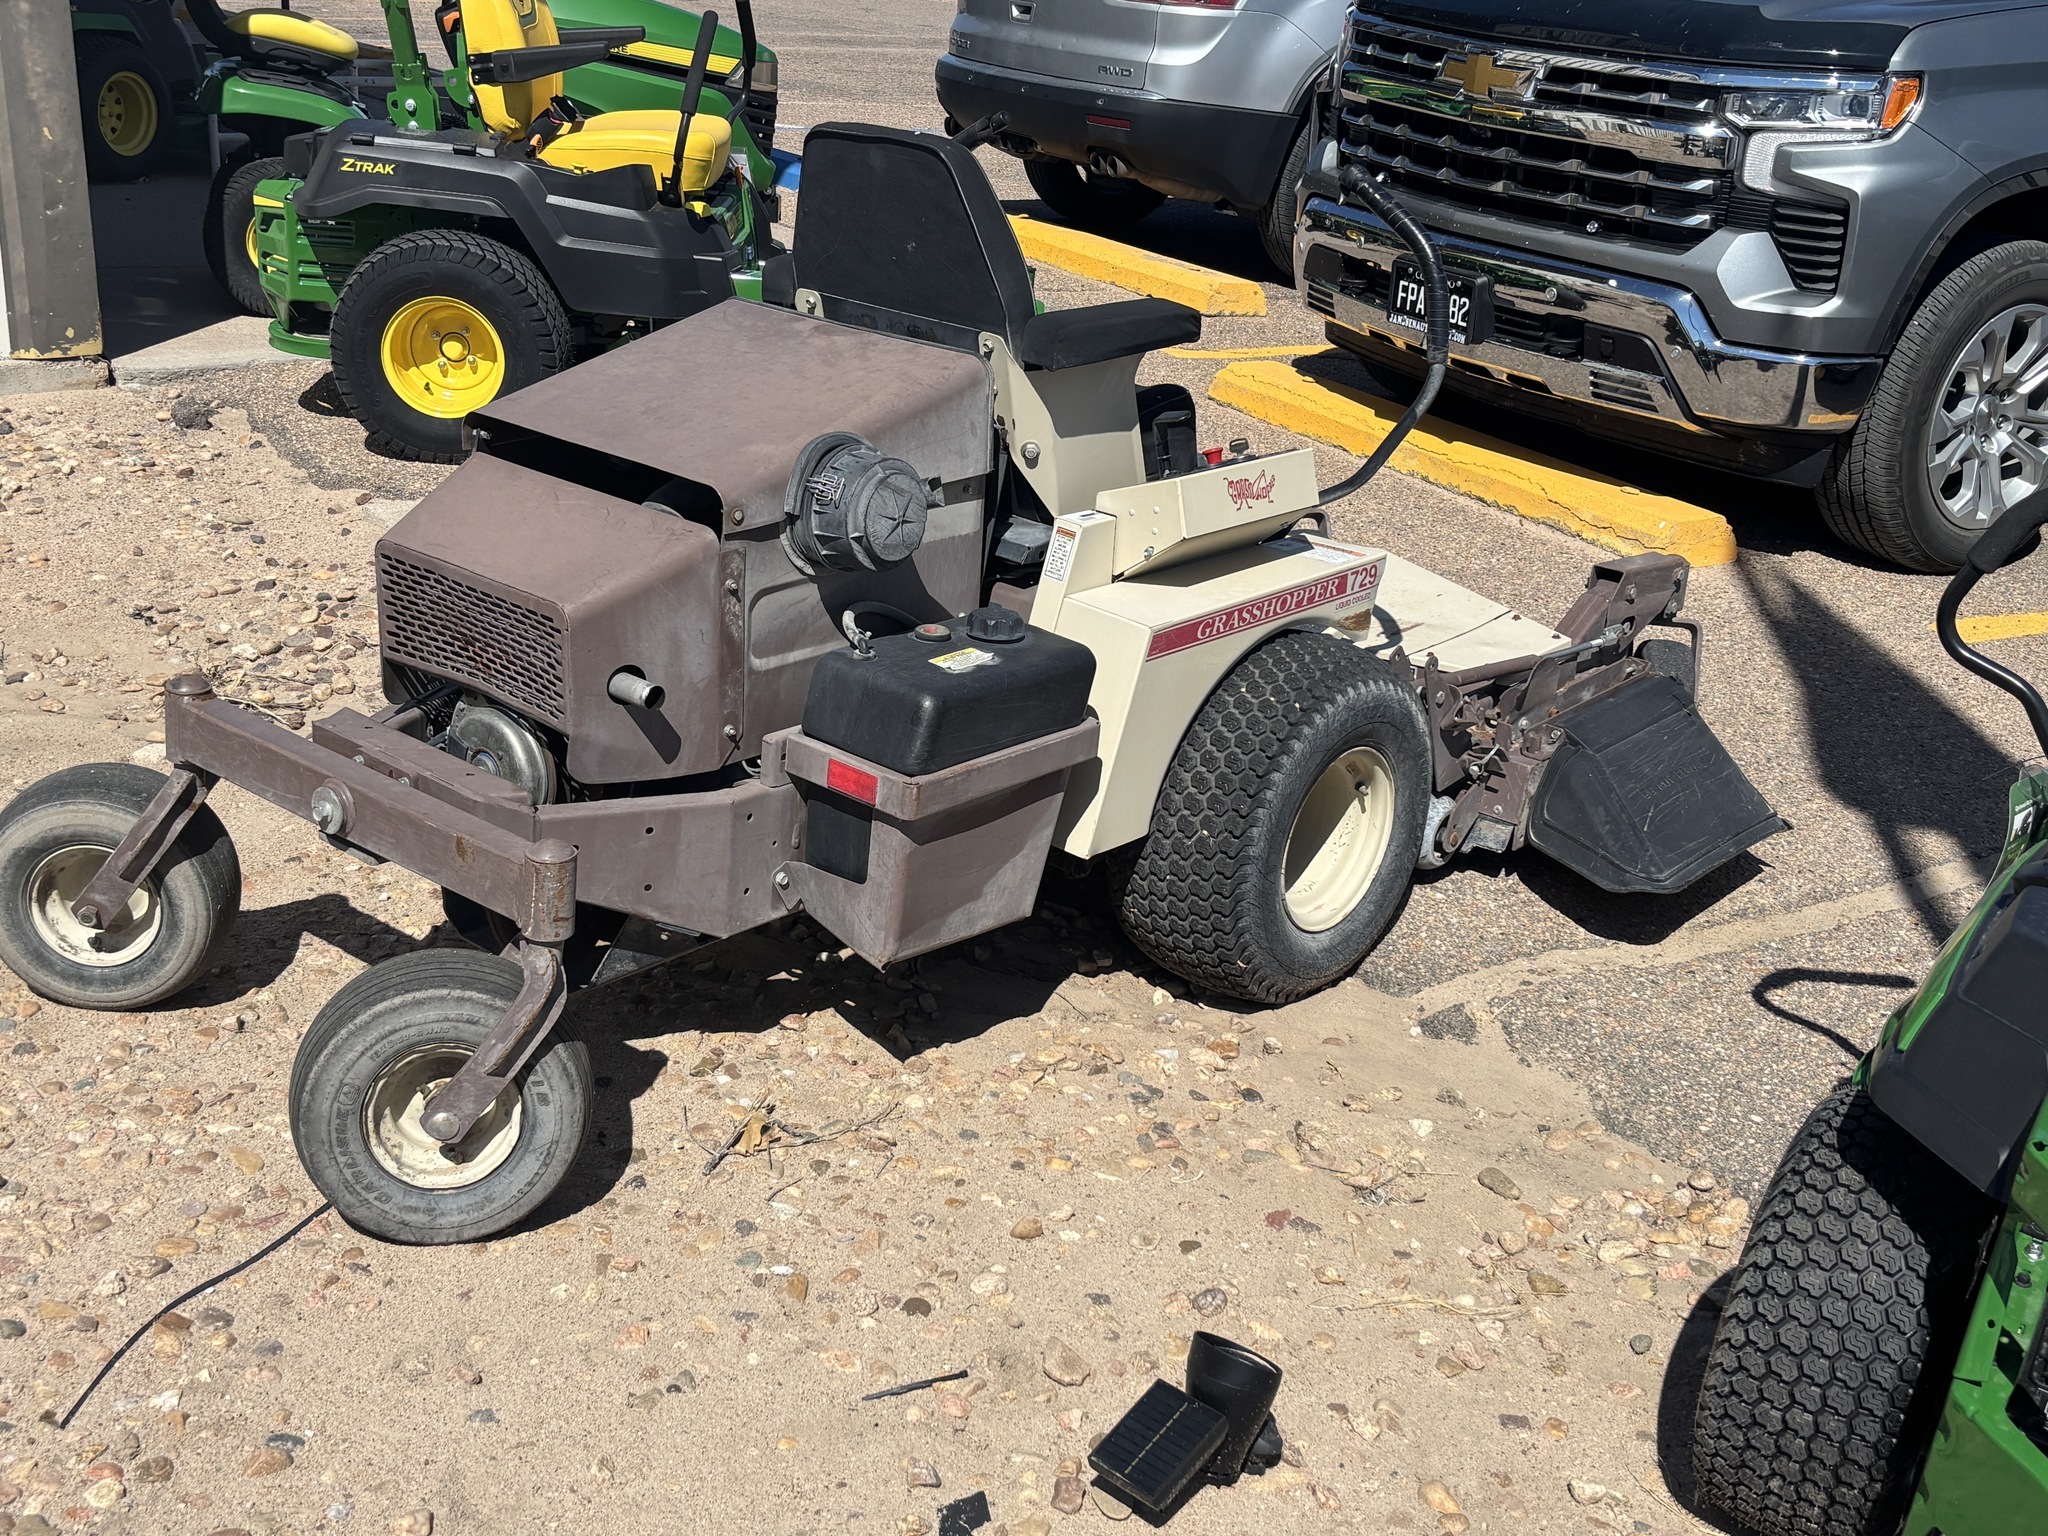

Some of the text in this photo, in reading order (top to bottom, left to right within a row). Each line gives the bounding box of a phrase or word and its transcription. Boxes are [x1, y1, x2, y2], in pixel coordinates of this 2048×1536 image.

[340, 158, 396, 175] ZTRAK
[1396, 280, 1469, 327] FPA 82
[1196, 564, 1378, 639] GRASSHOPPER 729
[1335, 592, 1371, 611] LIQUID COOLED
